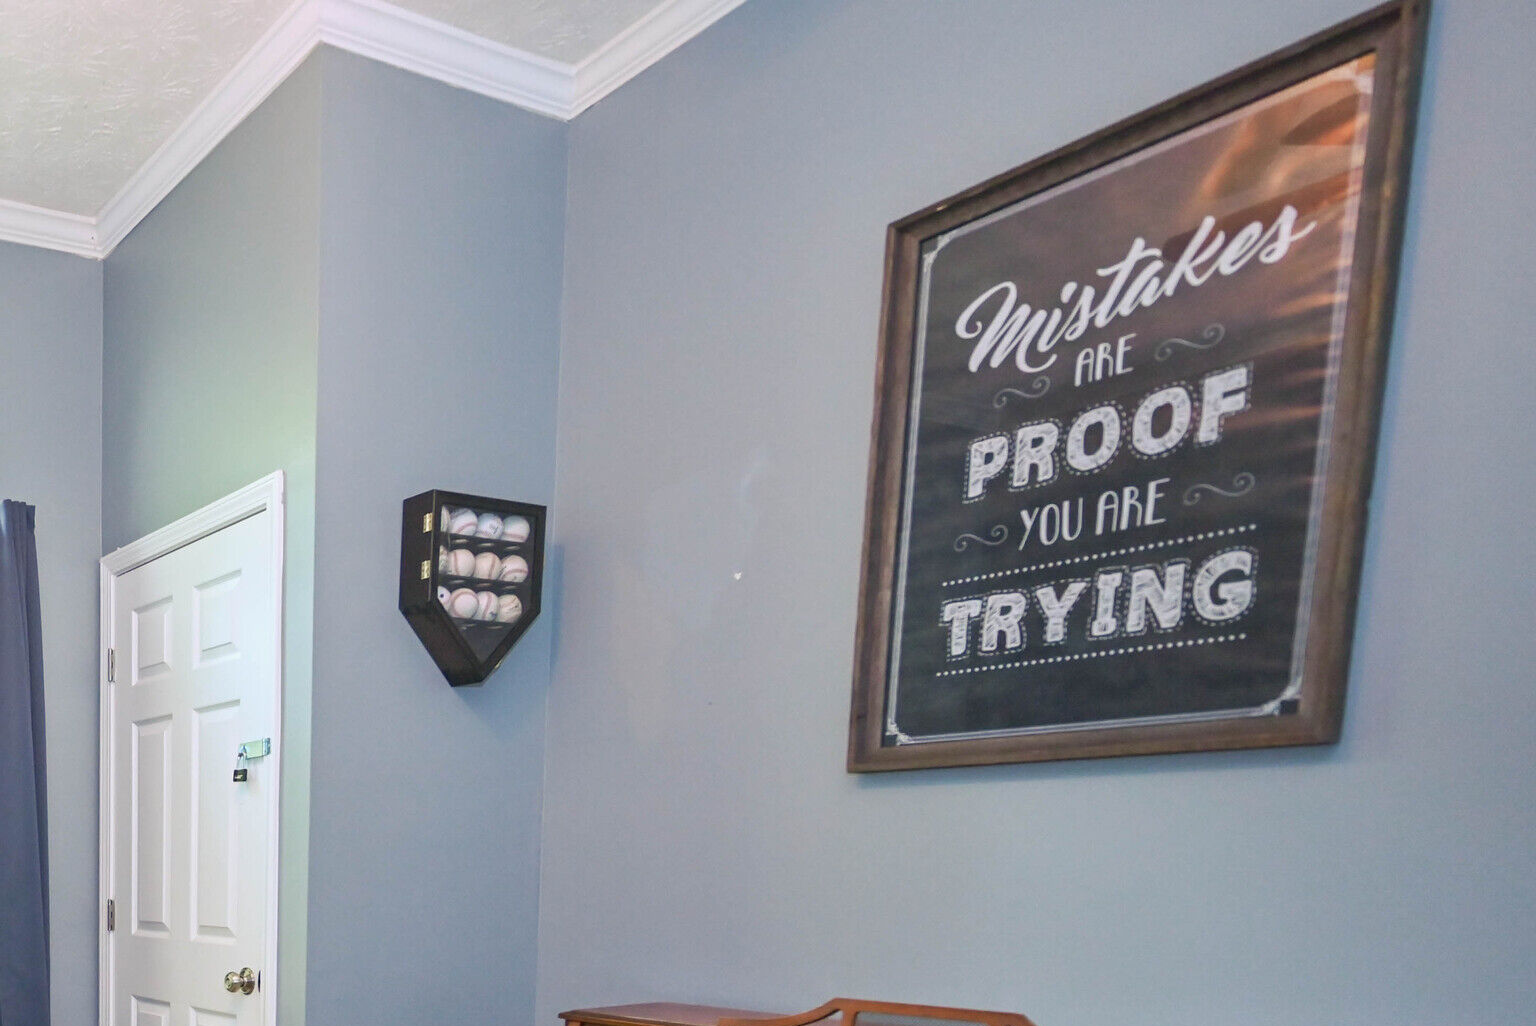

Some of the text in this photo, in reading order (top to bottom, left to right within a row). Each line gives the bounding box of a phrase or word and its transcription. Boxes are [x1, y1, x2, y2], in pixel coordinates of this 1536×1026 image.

[955, 204, 1317, 374] Mistakes
[1074, 333, 1137, 387] ARE
[965, 365, 1252, 502] PROOF
[1018, 477, 1171, 551] YOU ARE
[942, 547, 1257, 660] TRYING
